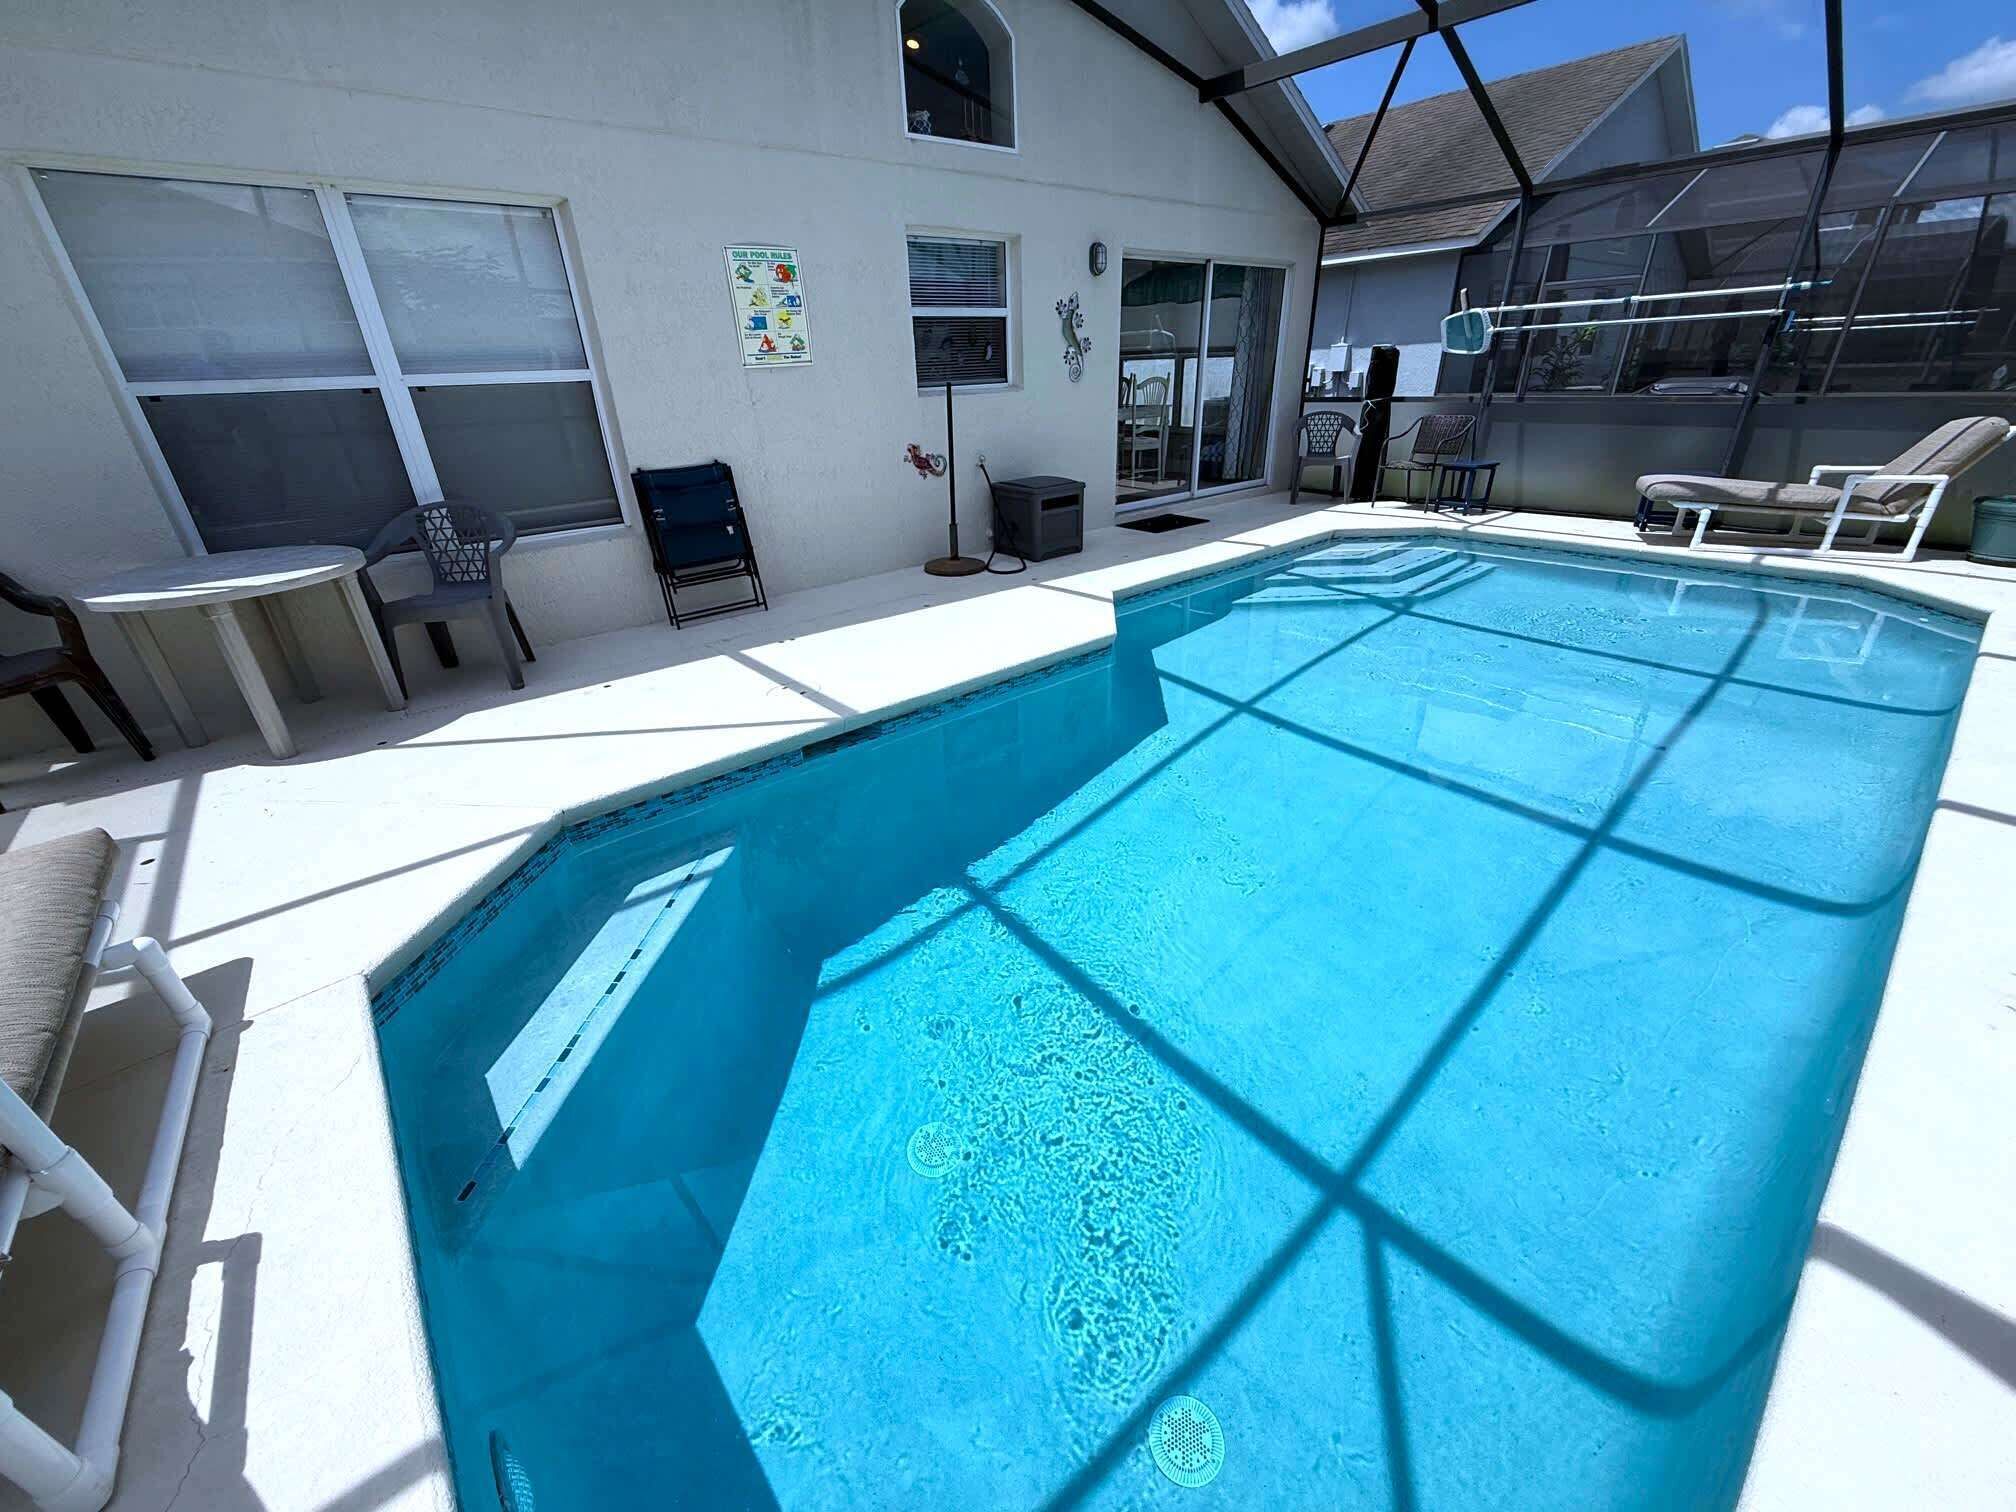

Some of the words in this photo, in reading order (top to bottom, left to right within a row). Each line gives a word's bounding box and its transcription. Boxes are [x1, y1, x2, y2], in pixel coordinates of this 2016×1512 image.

[732, 250, 748, 258] OUR
[750, 251, 769, 259] POOL
[770, 252, 793, 260] RULES
